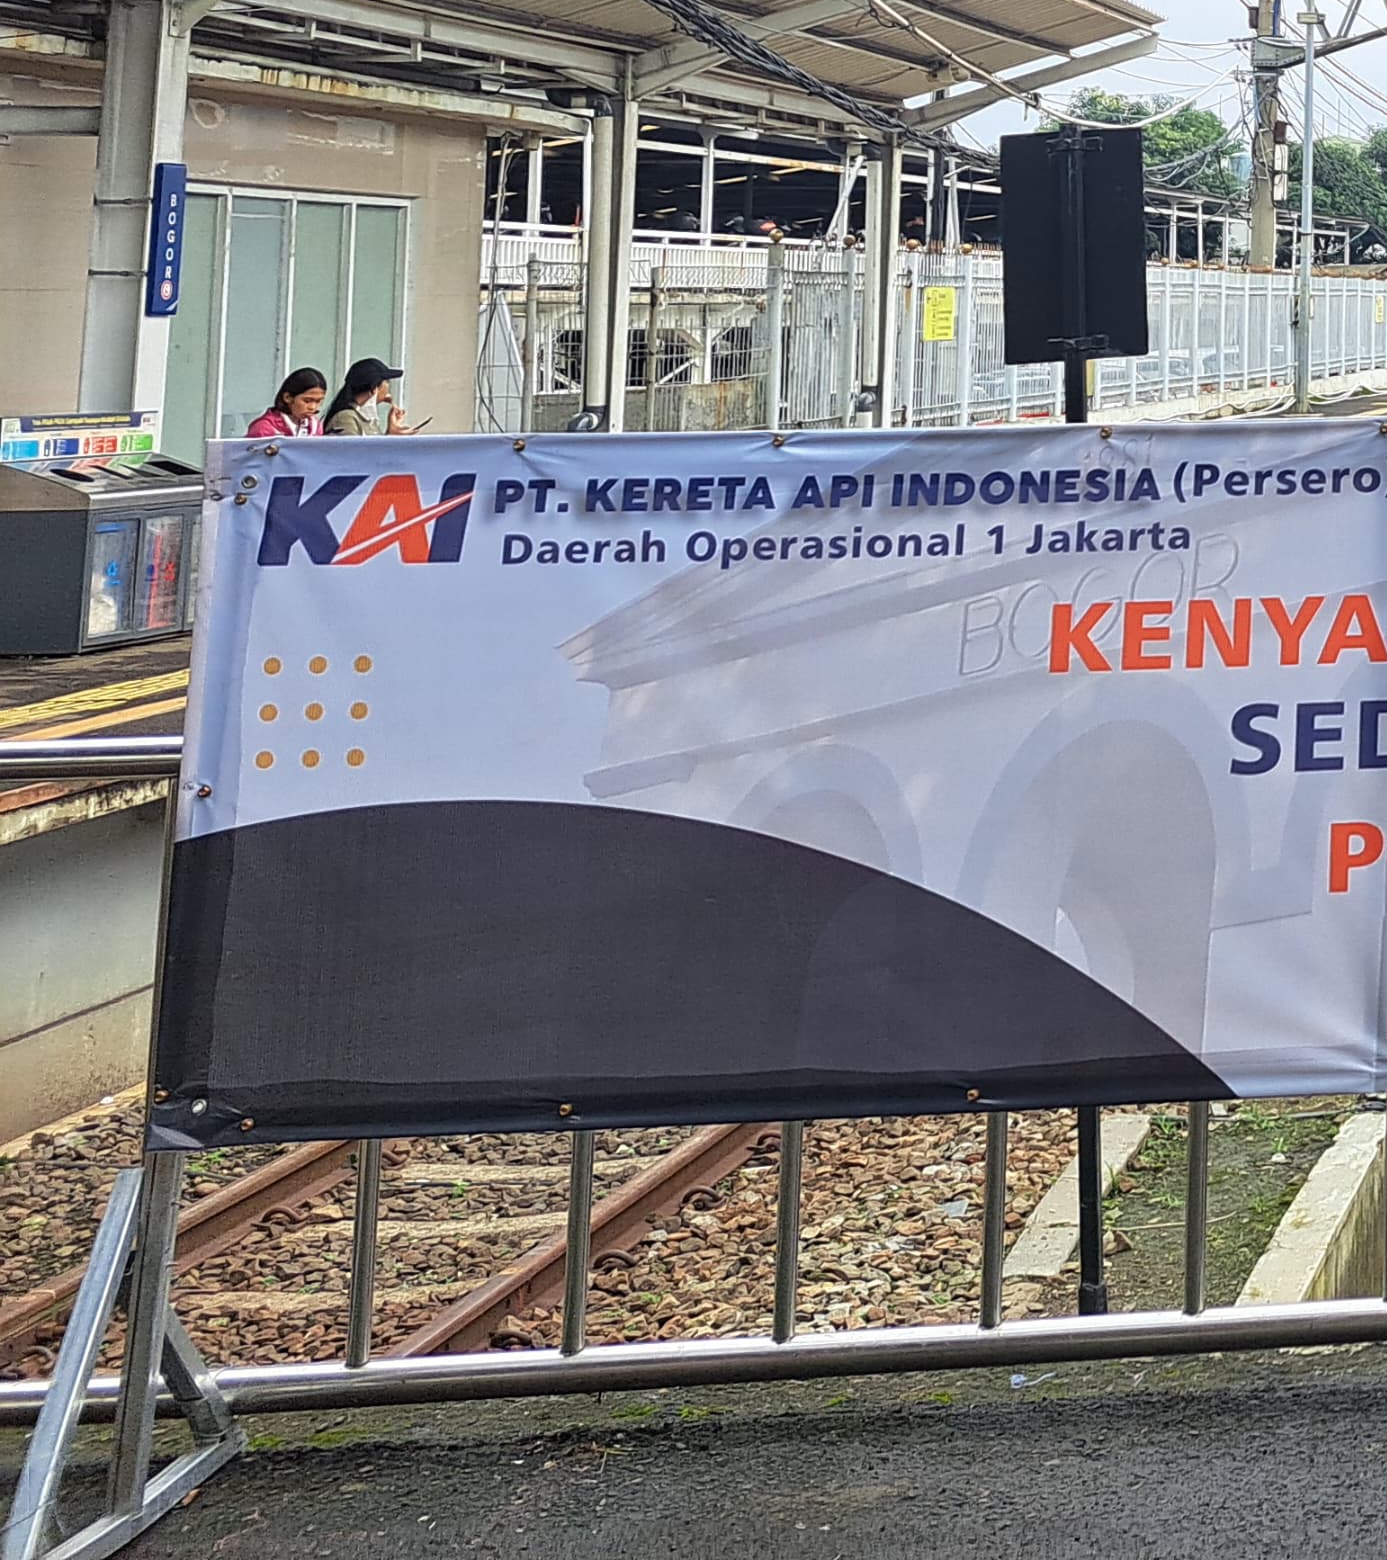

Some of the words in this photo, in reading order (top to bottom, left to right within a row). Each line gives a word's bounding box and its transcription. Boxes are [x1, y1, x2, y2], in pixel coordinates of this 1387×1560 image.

[164, 193, 177, 279] BOGOR
[256, 472, 477, 567] KAI
[492, 478, 568, 515] PT.
[584, 474, 776, 513] KERETA
[789, 474, 874, 510] API
[890, 466, 1162, 508] INDONESIA
[501, 529, 667, 566] Daerah
[685, 522, 966, 570] Operasional
[986, 524, 1004, 555] 1
[1025, 520, 1192, 555] Jakarta
[958, 532, 1240, 677] BOGOR
